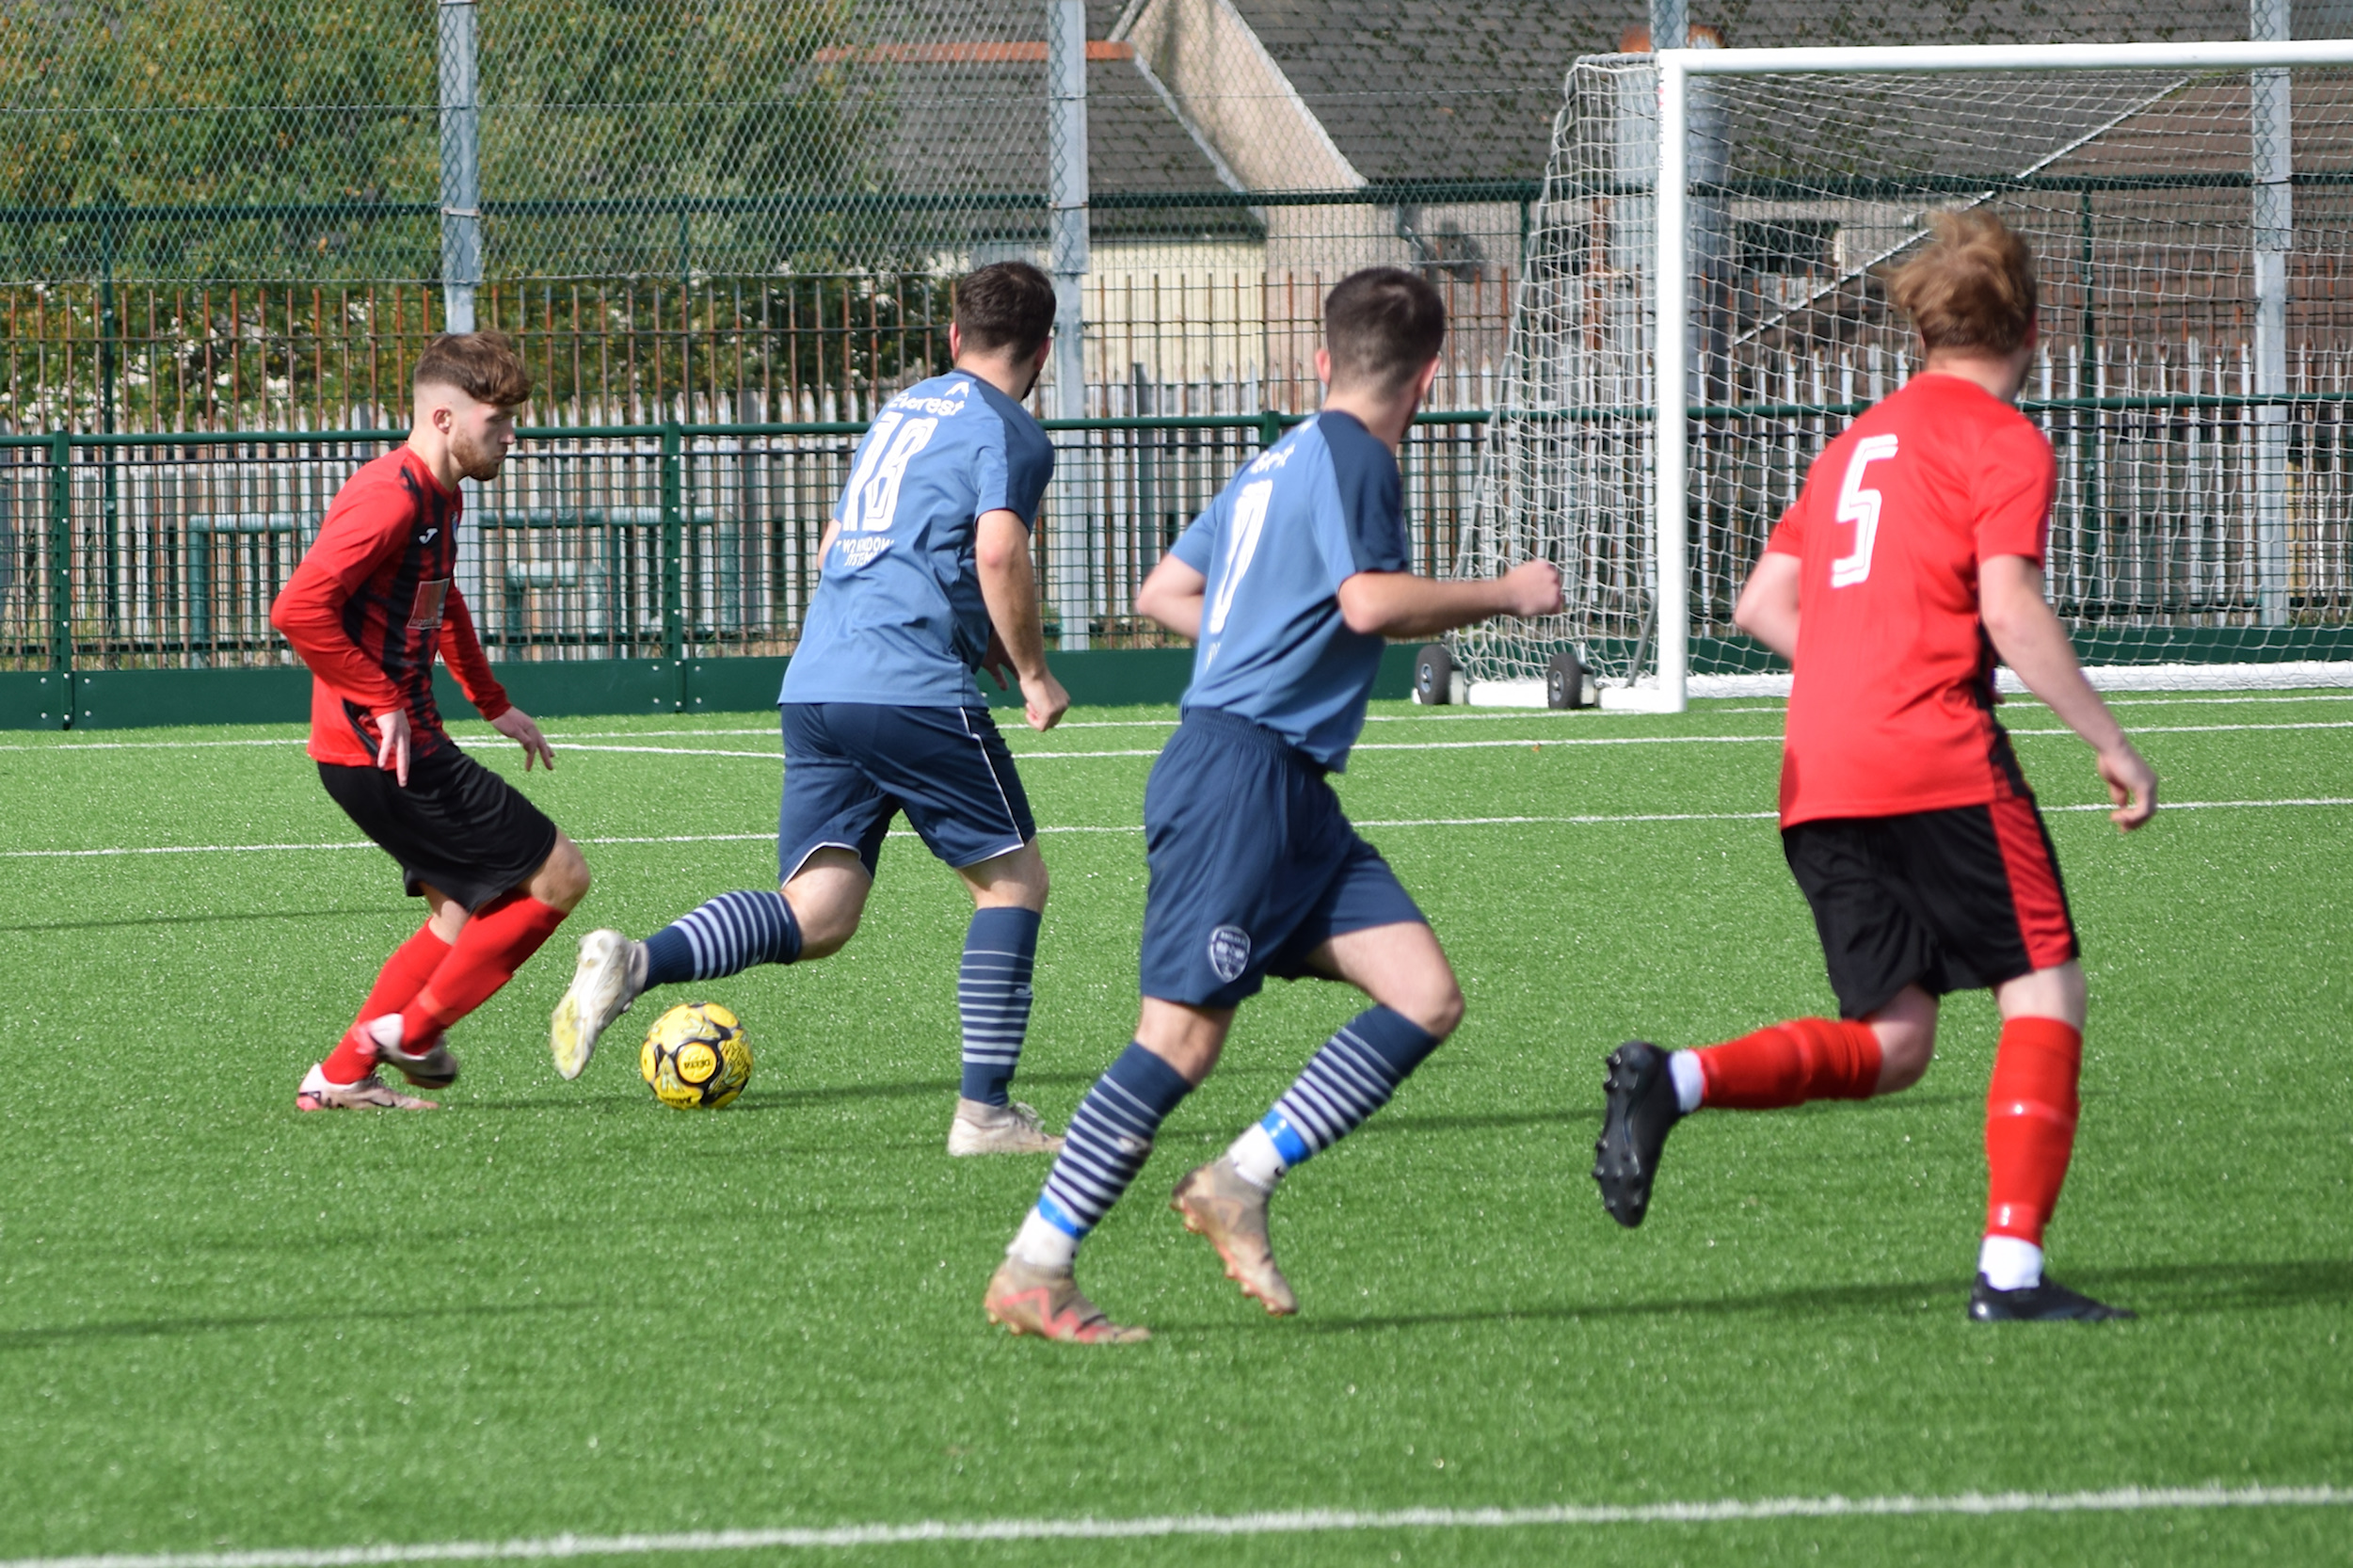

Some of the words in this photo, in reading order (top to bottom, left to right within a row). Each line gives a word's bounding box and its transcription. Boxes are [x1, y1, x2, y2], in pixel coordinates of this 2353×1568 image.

[888, 392, 966, 416] Everest
[843, 411, 938, 531] 18
[1832, 433, 1899, 587] 5
[684, 1058, 711, 1069] DELTA
